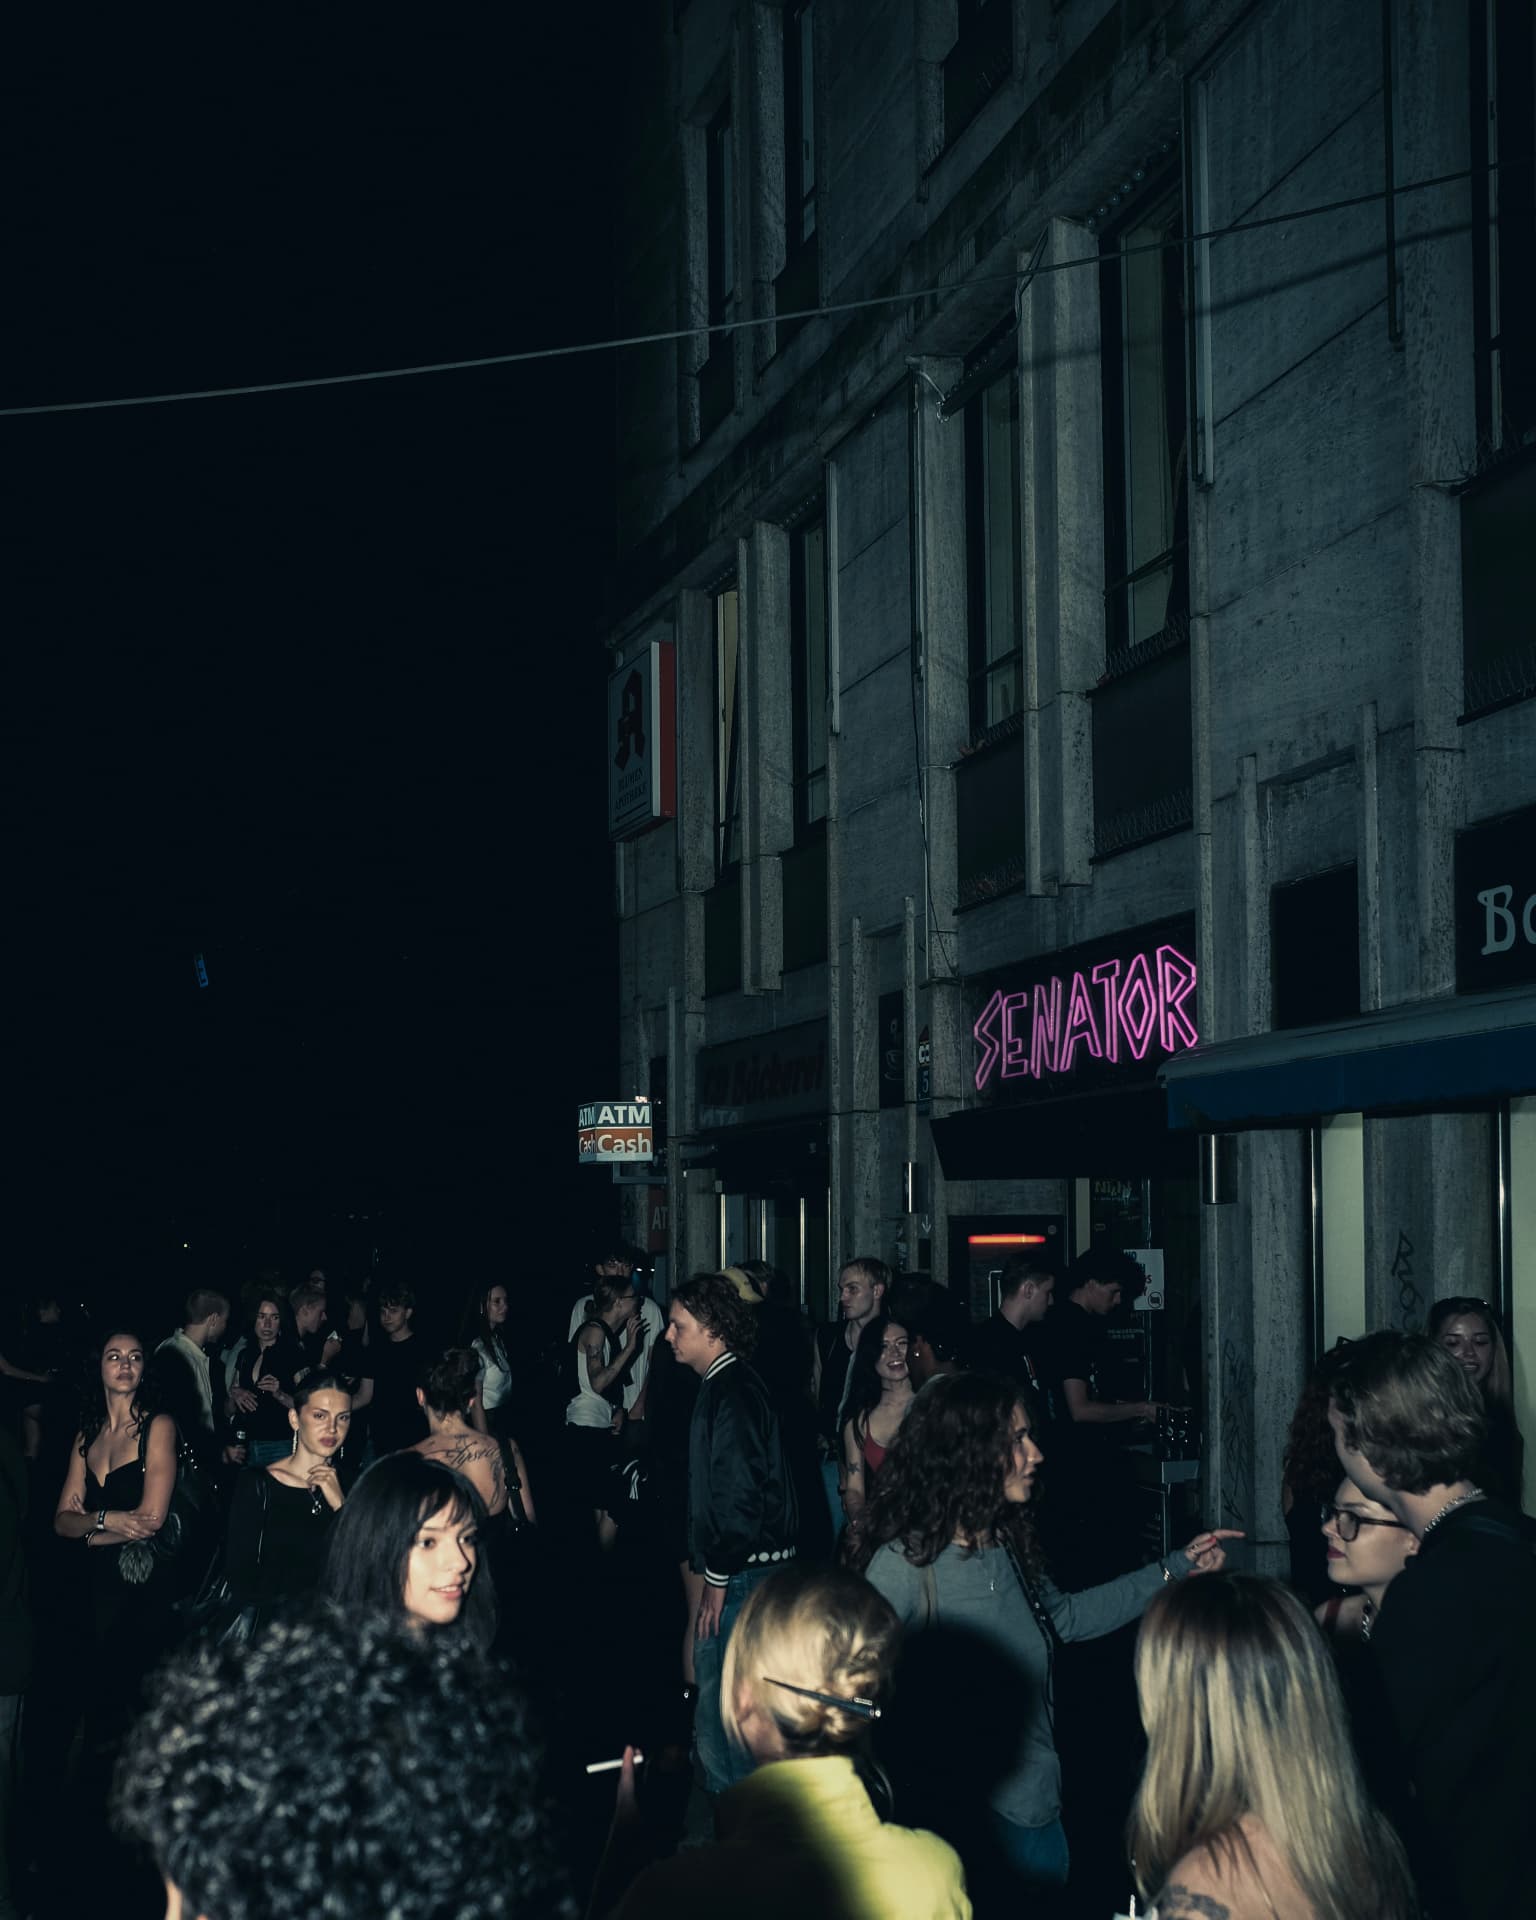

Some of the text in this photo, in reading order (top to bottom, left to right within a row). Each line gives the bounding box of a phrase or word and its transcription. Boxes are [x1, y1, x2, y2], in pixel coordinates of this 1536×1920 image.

[974, 944, 1198, 1091] SENATOR
[578, 1106, 595, 1128] ATM
[597, 1105, 650, 1124] ATM
[579, 1133, 597, 1154] Cash
[597, 1132, 651, 1154] Cash
